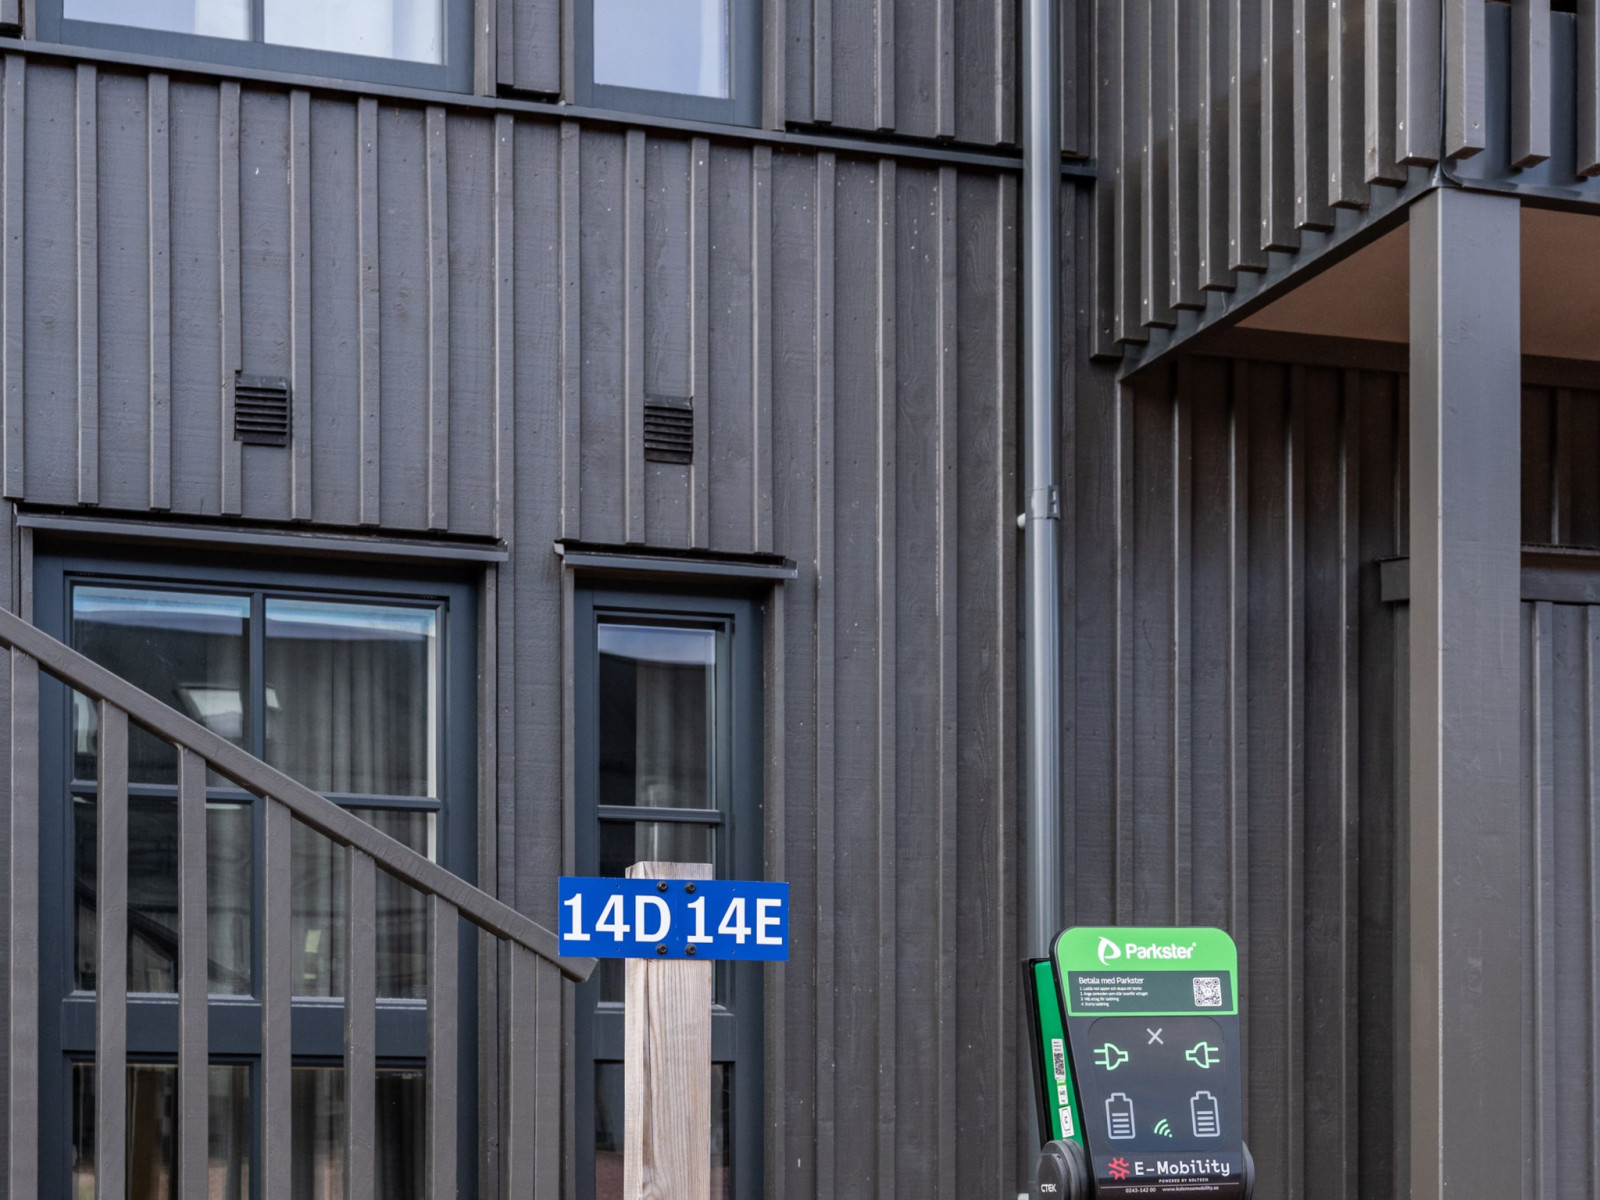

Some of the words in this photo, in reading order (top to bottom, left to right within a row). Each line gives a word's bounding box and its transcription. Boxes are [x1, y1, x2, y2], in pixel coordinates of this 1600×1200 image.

[563, 893, 671, 942] 14D
[687, 896, 783, 945] 14E
[1125, 943, 1195, 960] Parkster
[1078, 977, 1100, 985] Betala
[1101, 977, 1115, 985] med
[1116, 977, 1144, 985] Parkster
[1134, 1159, 1230, 1177] E-Mobility
[1040, 1183, 1058, 1193] CTEK
